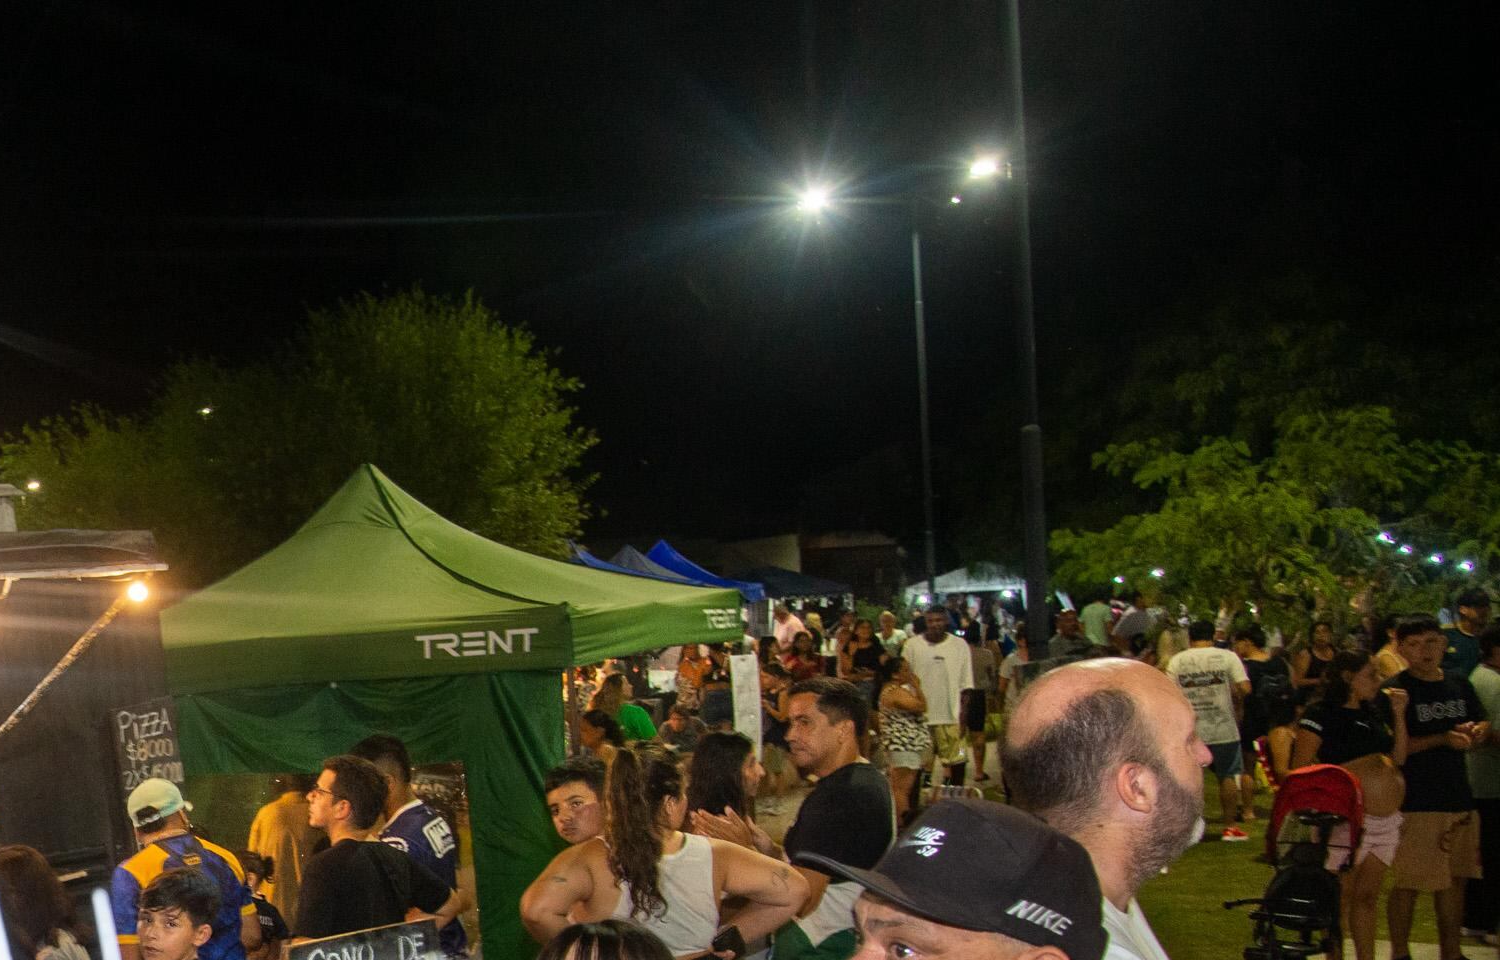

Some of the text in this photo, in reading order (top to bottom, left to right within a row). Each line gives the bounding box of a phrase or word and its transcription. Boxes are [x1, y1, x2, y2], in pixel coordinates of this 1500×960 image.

[414, 627, 539, 659] TRENT
[1416, 699, 1468, 722] BOSS
[126, 738, 174, 769] $8000
[1005, 900, 1073, 936] NIKE
